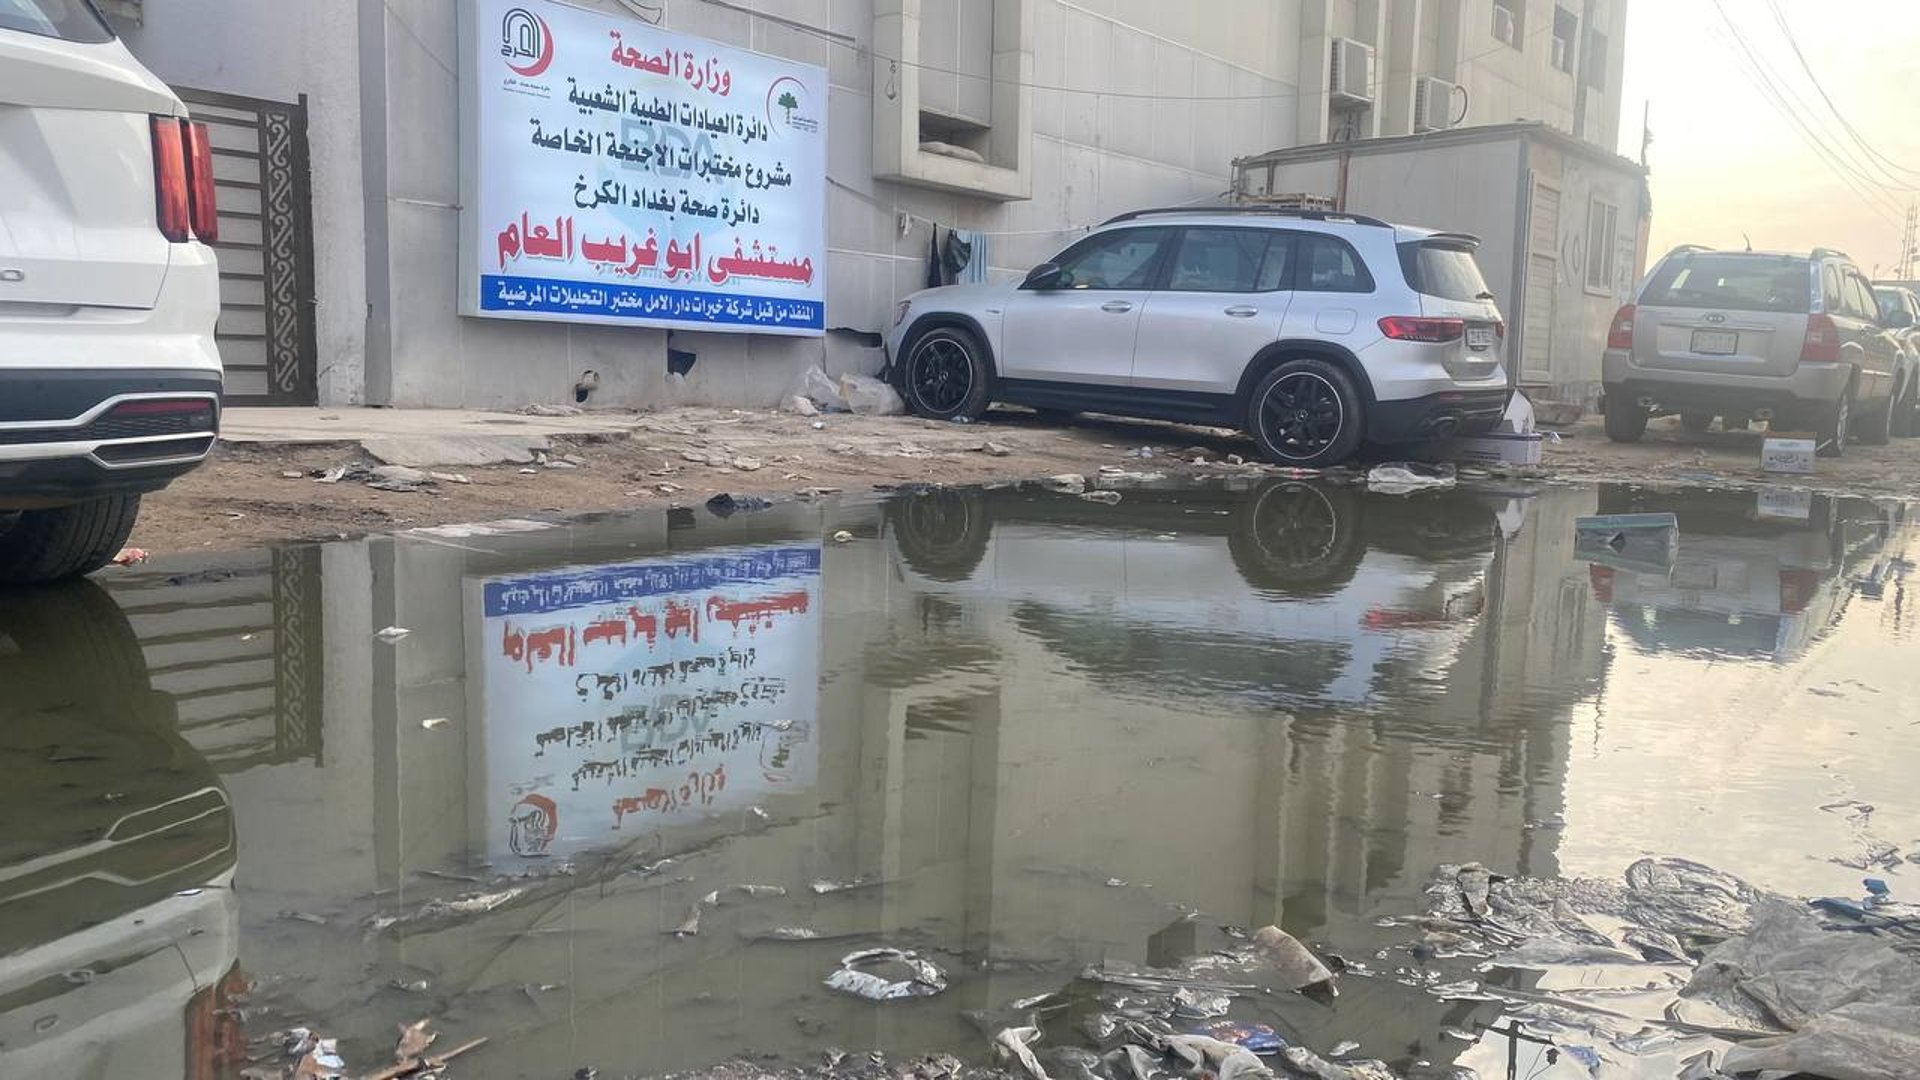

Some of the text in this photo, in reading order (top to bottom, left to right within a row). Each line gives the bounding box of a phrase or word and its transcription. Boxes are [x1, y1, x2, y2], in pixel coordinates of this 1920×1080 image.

[610, 31, 731, 96] وزارة الصحة
[567, 76, 626, 115] الشعبية
[629, 90, 677, 126] الطبية
[680, 103, 735, 139] العيادات
[737, 114, 768, 144] دائرة
[530, 118, 792, 189] مشروع مختبرات الاجنحة الخاصة
[574, 173, 760, 227] دائرة صحة بغداد الكرخ
[497, 211, 814, 287] مستشفى ابو غريب العام
[498, 280, 814, 322] المنفذ من قبل شركة خيرات دار الامل مختبر التحليلات المرضية
